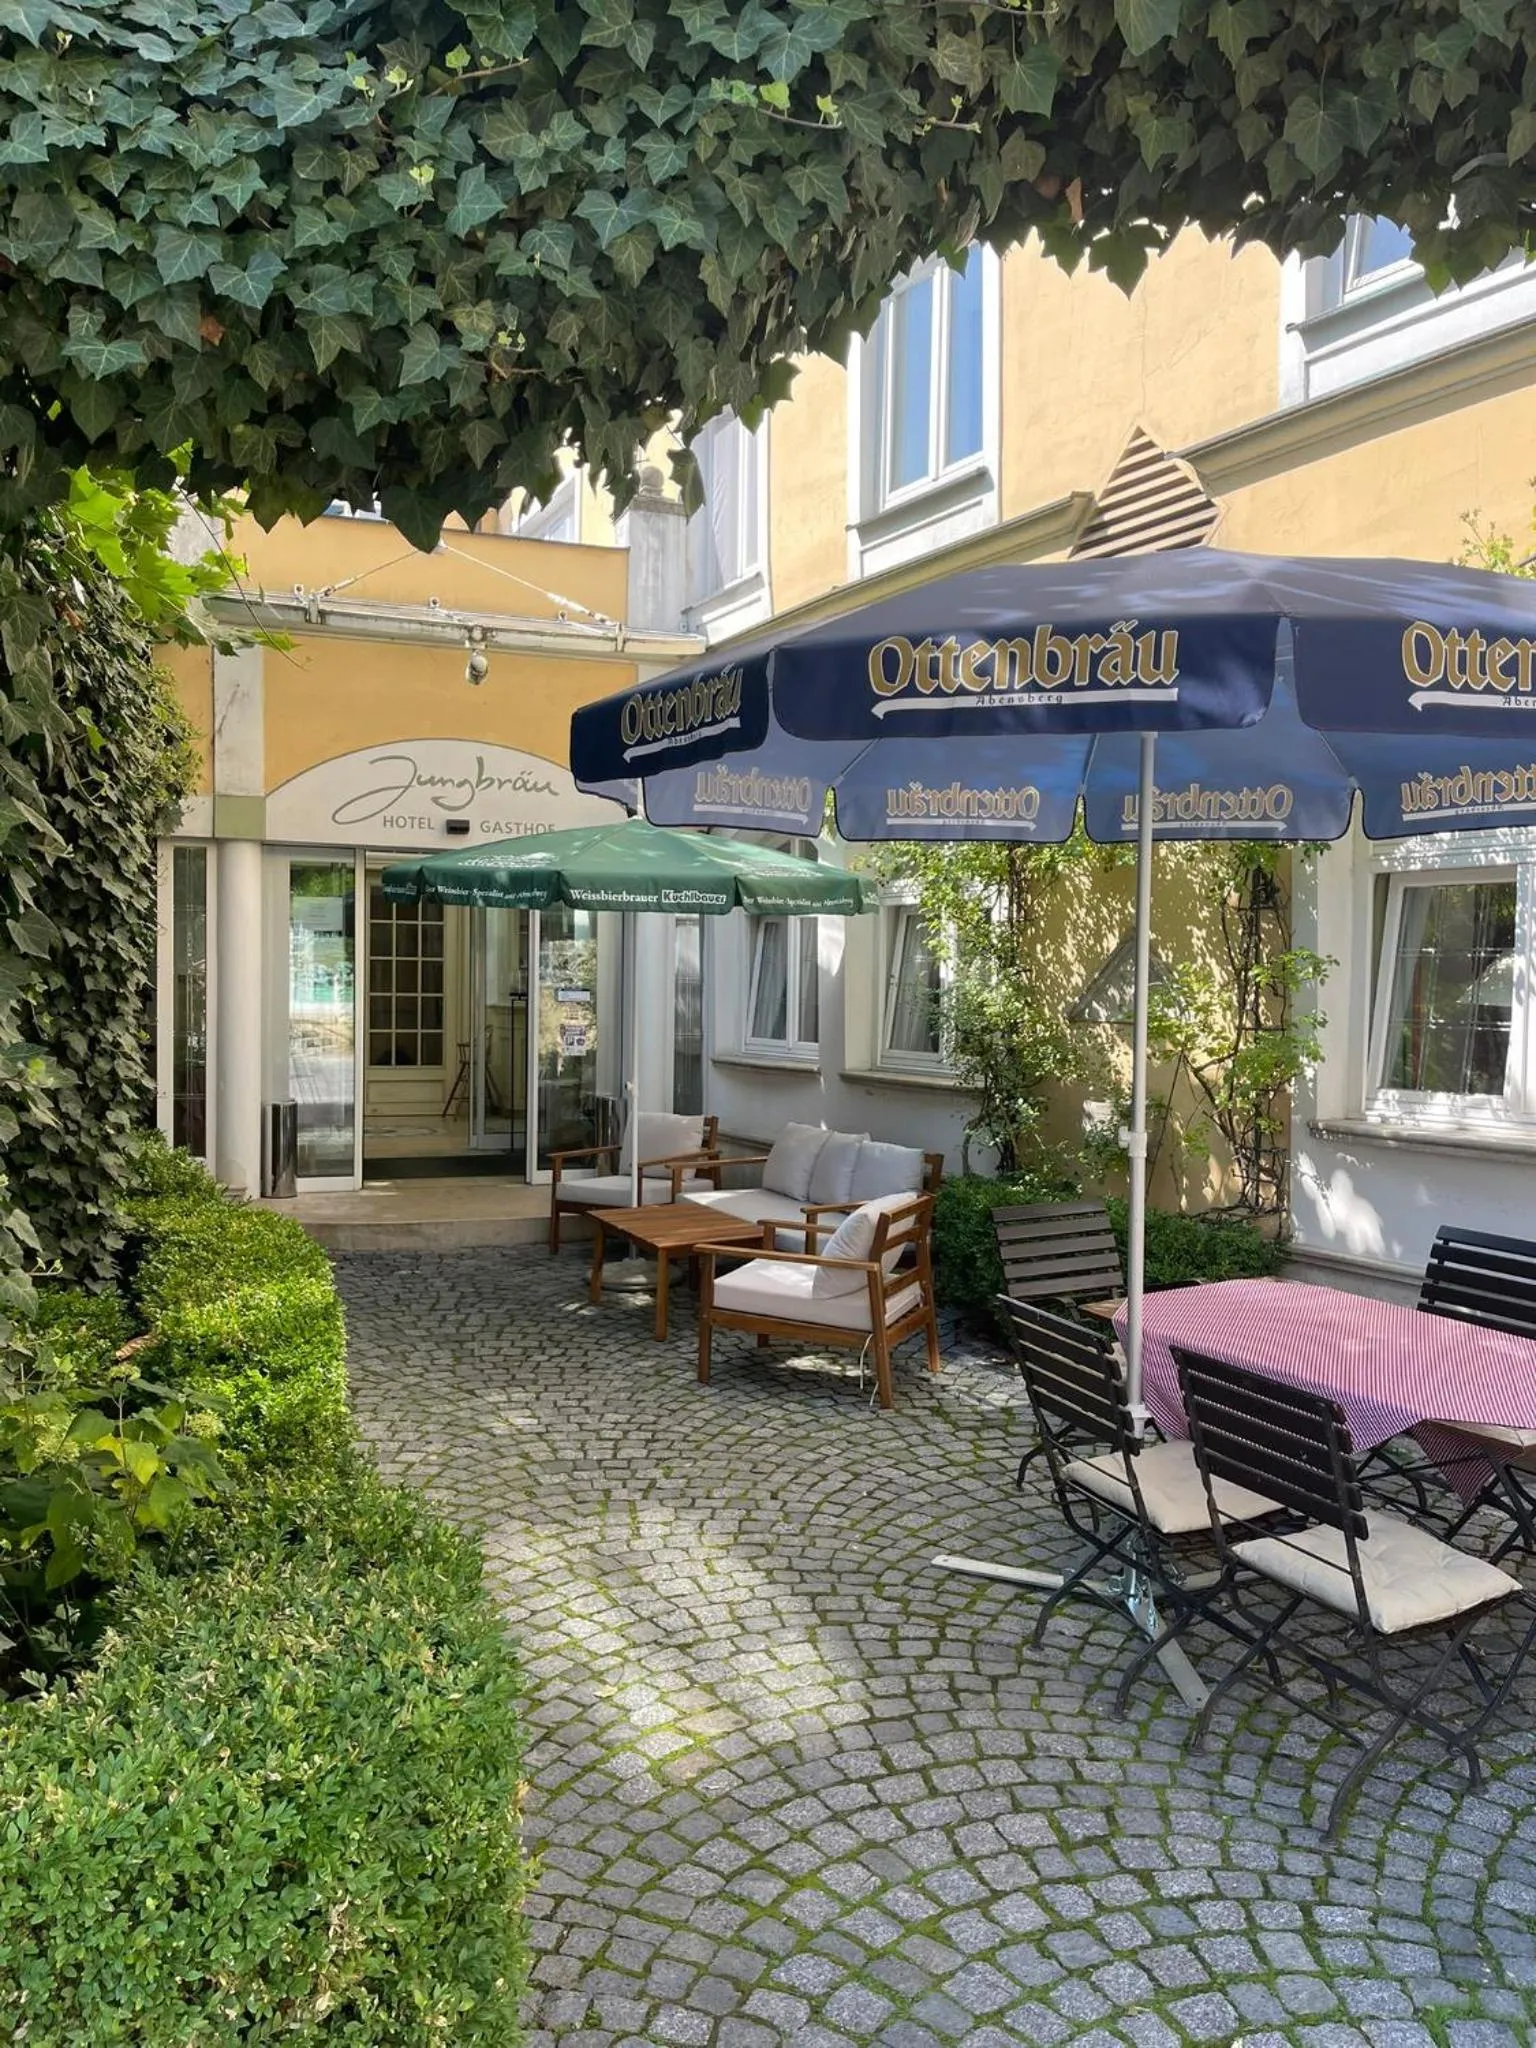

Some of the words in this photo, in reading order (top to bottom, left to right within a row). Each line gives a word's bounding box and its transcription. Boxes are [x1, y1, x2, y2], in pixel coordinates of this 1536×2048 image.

[868, 619, 1180, 697] Ottenbräu
[620, 663, 744, 745] Ottenbräu
[331, 755, 560, 825] Jungbräu
[383, 815, 435, 831] HOTEL
[570, 889, 659, 903] Weissbierbrauer
[661, 889, 727, 905] Kuchlbauer
